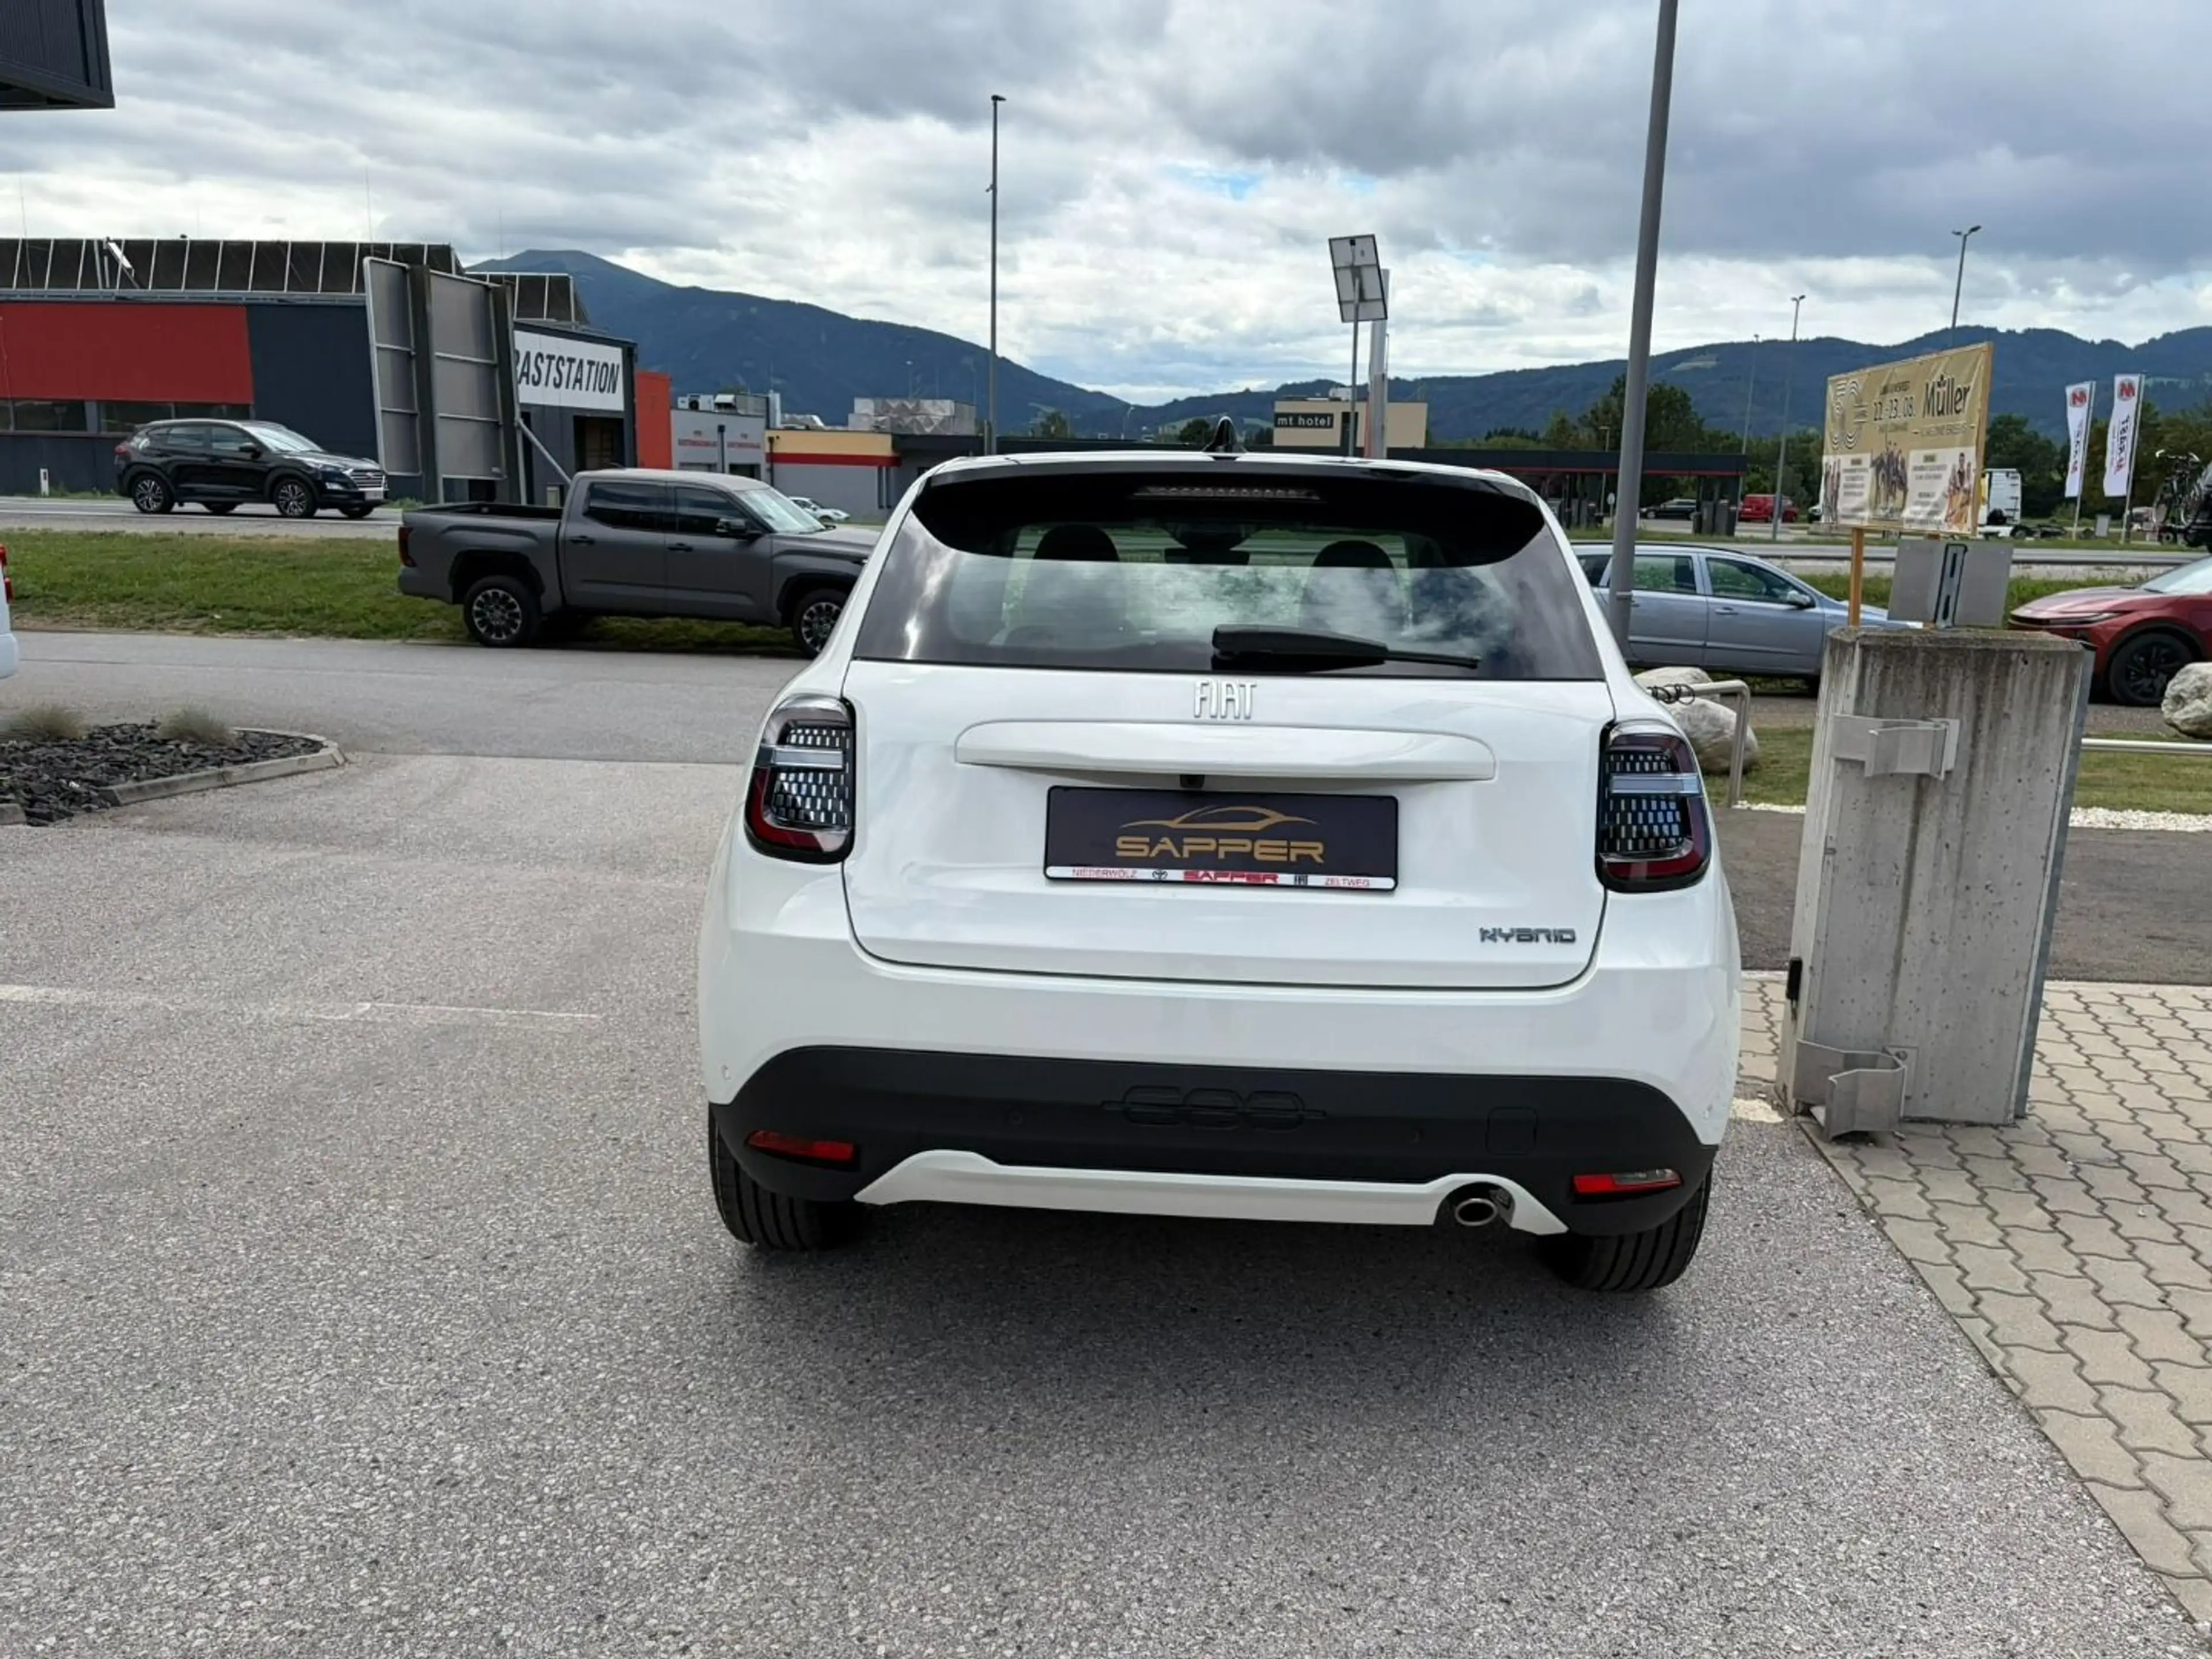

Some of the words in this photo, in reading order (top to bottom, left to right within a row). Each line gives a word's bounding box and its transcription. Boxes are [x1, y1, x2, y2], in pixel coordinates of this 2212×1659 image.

[1922, 374, 1972, 419] Müller
[1278, 416, 1293, 426] mt
[1297, 415, 1332, 427] hotel
[1194, 679, 1257, 719] FIAT
[1115, 836, 1324, 863] SAPPER
[1183, 870, 1279, 884] SAPPER
[1479, 927, 1576, 944] HYBRID
